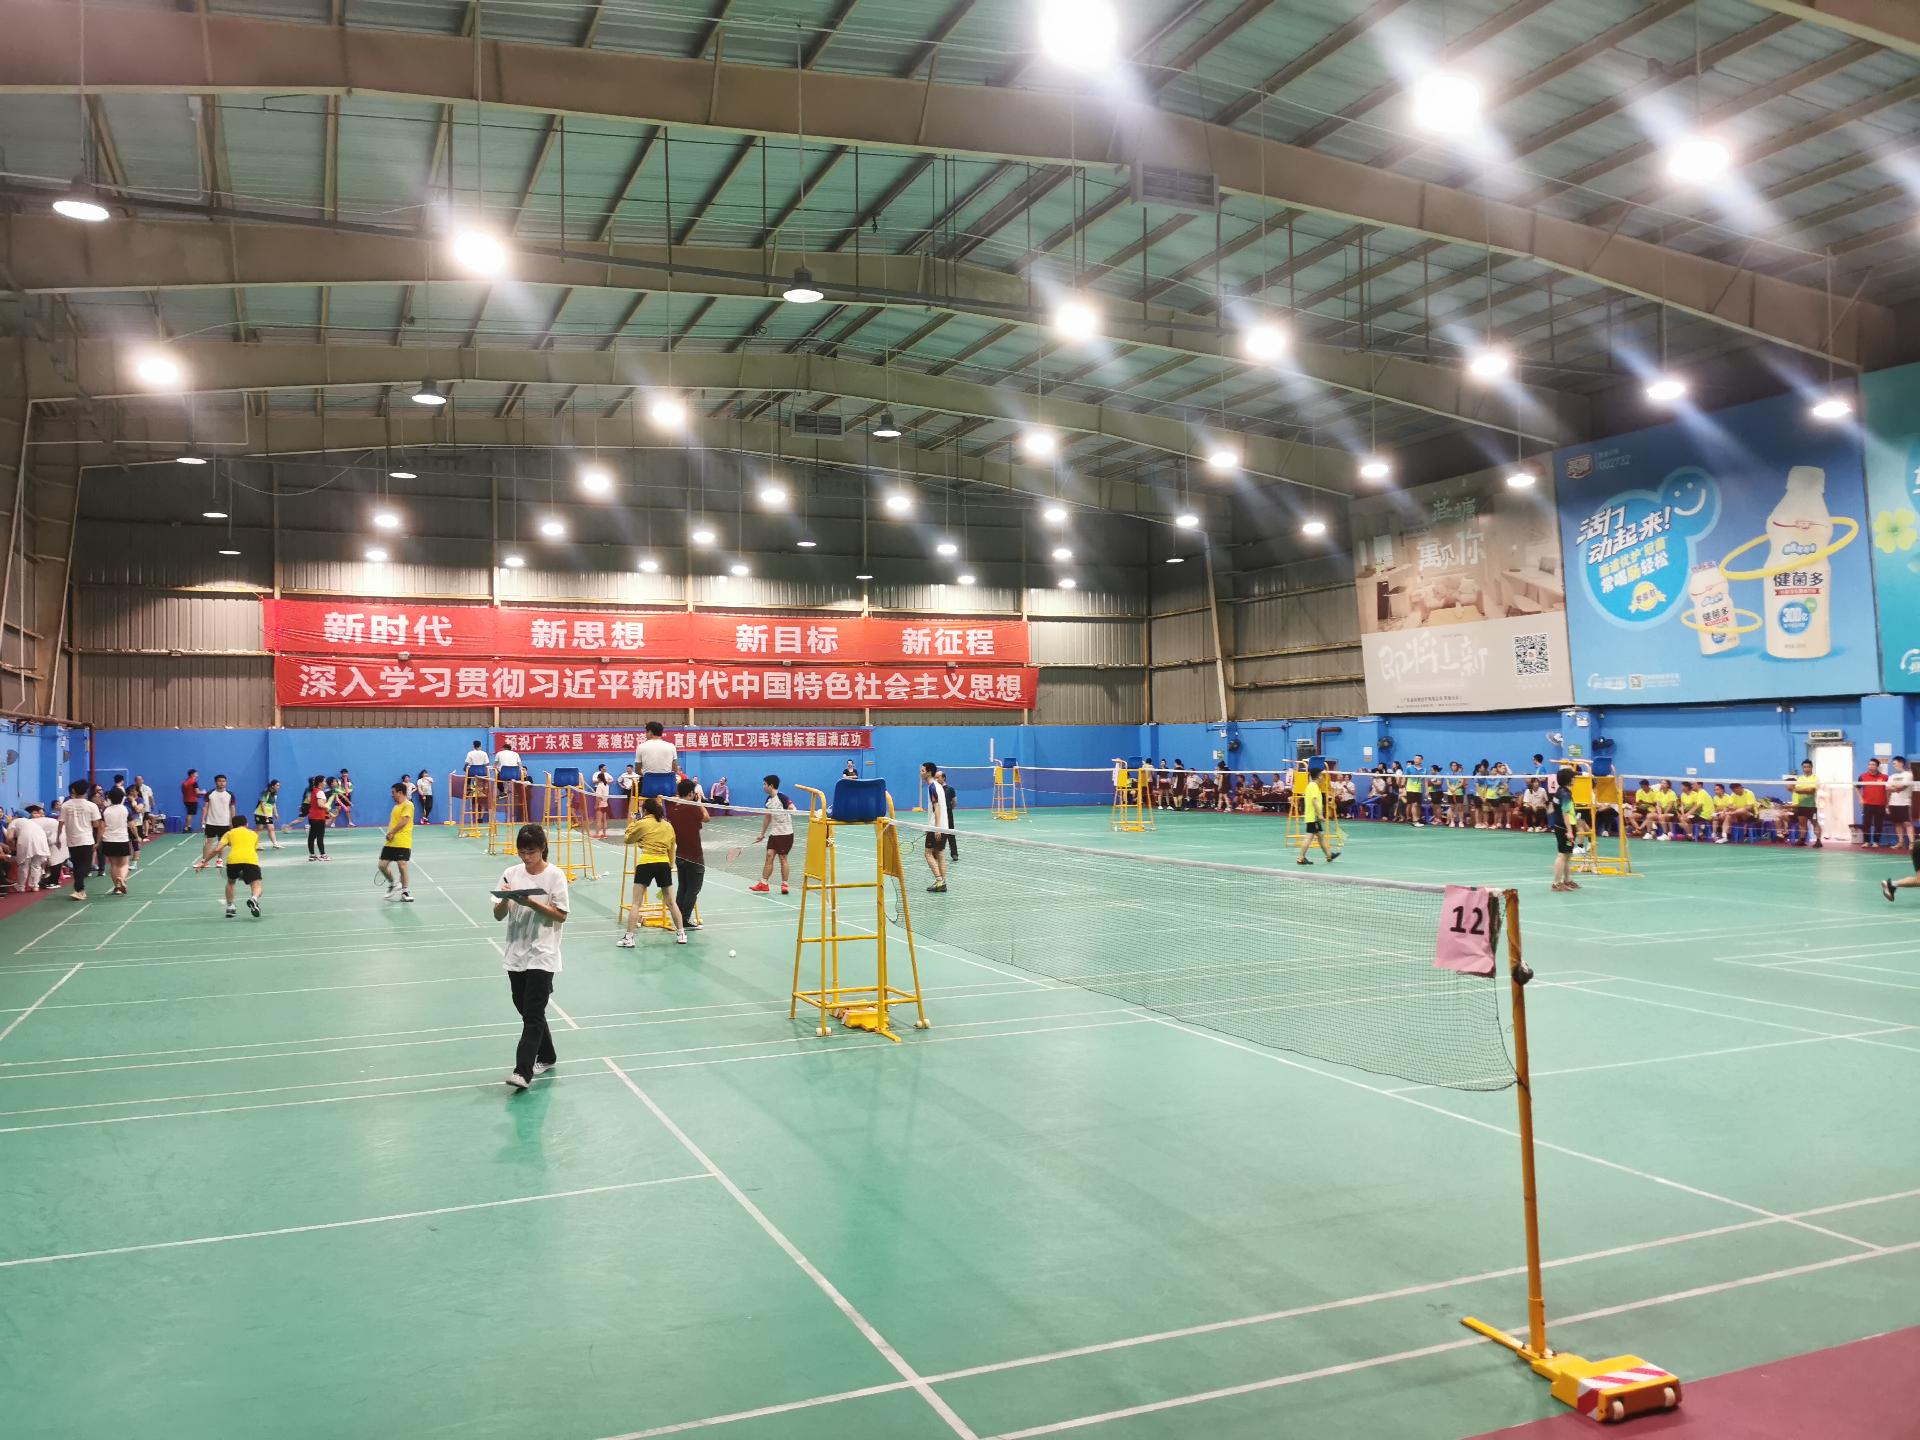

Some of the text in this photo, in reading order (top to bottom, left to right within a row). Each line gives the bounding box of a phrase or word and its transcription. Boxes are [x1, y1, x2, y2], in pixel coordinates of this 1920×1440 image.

[1773, 572, 1824, 587] 健菌多
[323, 611, 995, 656] 新时代 新思想 新目标 新征程
[300, 664, 1021, 702] 深入学习贯彻习近平新时代中国特色社会主义思想
[1449, 905, 1485, 936] 12
